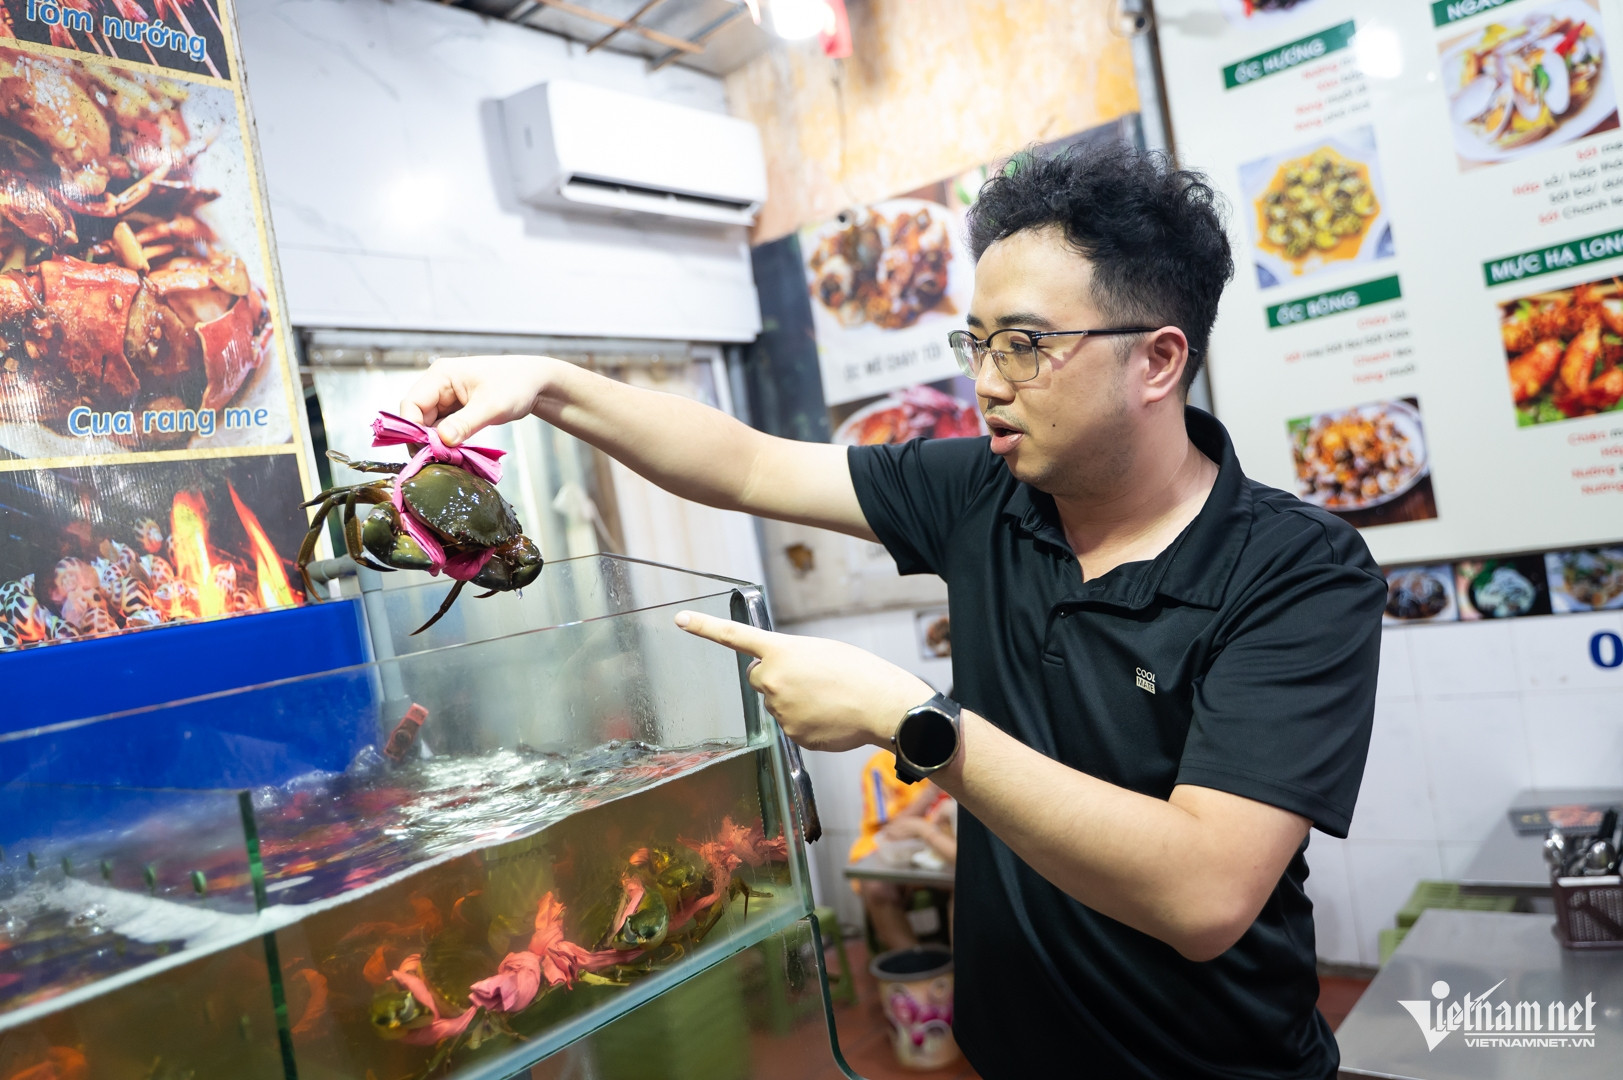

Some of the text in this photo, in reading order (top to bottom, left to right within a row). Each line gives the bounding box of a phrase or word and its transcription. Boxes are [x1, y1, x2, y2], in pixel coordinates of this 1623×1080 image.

[102, 15, 206, 62] nướng
[1263, 38, 1327, 74] HƯƠNG
[1490, 232, 1623, 283] MỰC HẠ LON
[68, 405, 269, 437] Cua rang me
[1136, 667, 1156, 683] COOL
[1136, 676, 1155, 694] MATE
